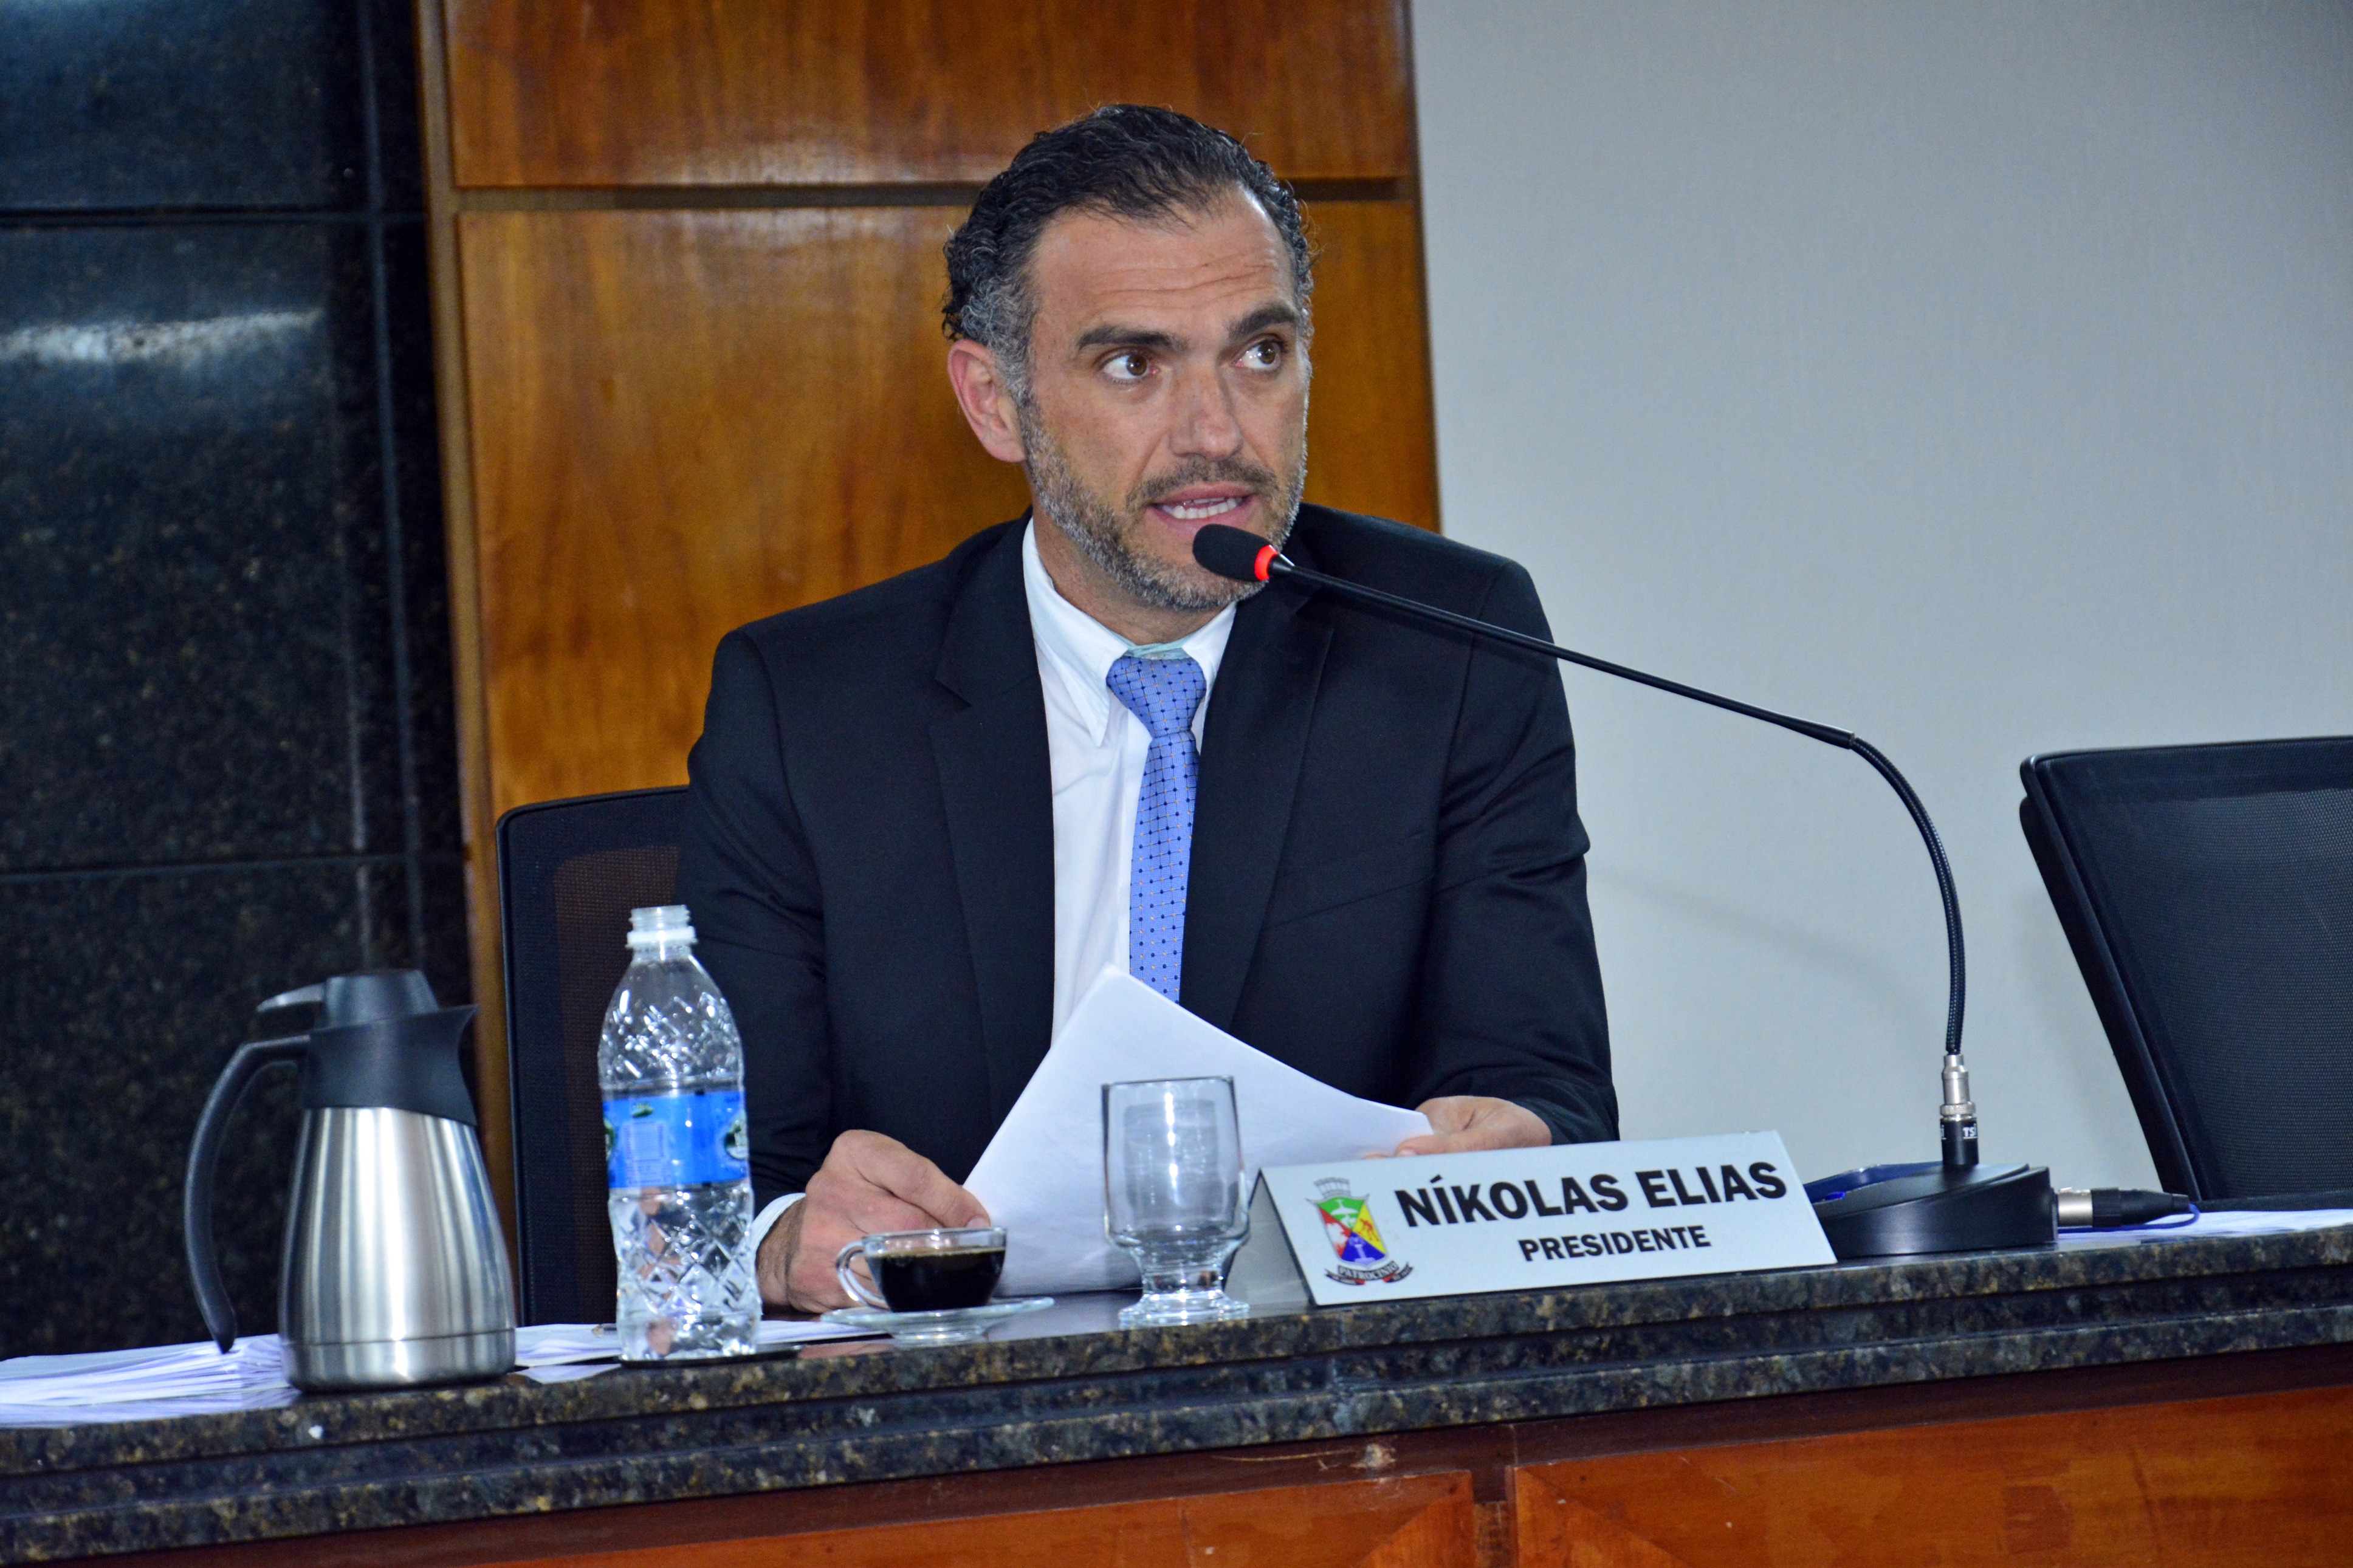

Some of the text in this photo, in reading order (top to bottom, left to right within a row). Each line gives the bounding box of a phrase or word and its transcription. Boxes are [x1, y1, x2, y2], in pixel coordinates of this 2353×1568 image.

[1394, 1162, 1787, 1227] NÍKOLAS ELIAS
[1518, 1225, 1711, 1262] PRESIDENTE
